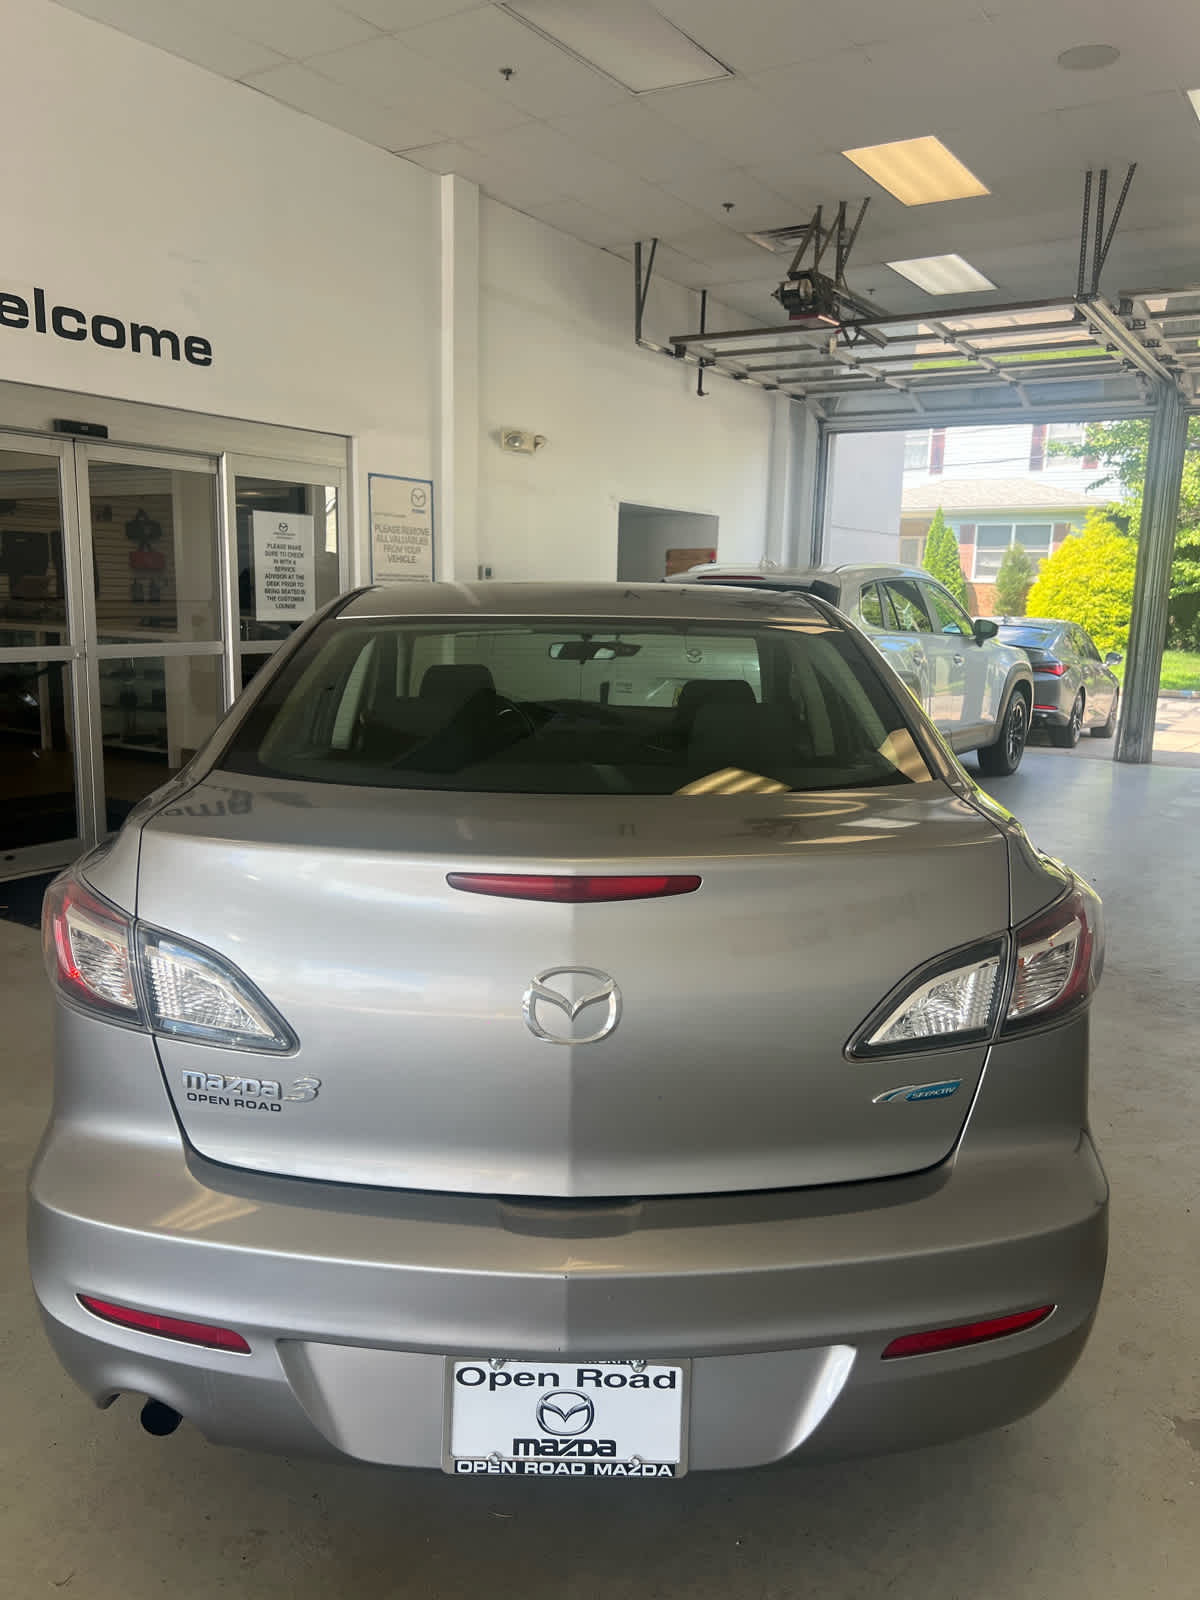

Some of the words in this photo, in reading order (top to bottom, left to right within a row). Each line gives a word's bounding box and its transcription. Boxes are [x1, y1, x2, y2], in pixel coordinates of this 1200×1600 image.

[375, 524, 400, 534] PLEASE
[401, 526, 430, 536] REMOVE
[376, 534, 389, 543] ALL
[389, 535, 429, 546] VALUABLES
[383, 544, 403, 553] FROM
[404, 545, 422, 554] YOUR
[387, 553, 416, 564] VEHICLE
[283, 1076, 322, 1103] 3
[186, 1092, 230, 1106] OPEN
[234, 1098, 282, 1113] ROAD
[455, 1366, 560, 1391] Open
[576, 1368, 676, 1389] Road
[457, 1460, 517, 1474] OPEN
[524, 1461, 586, 1475] ROAD
[593, 1462, 673, 1477] MAZDA
